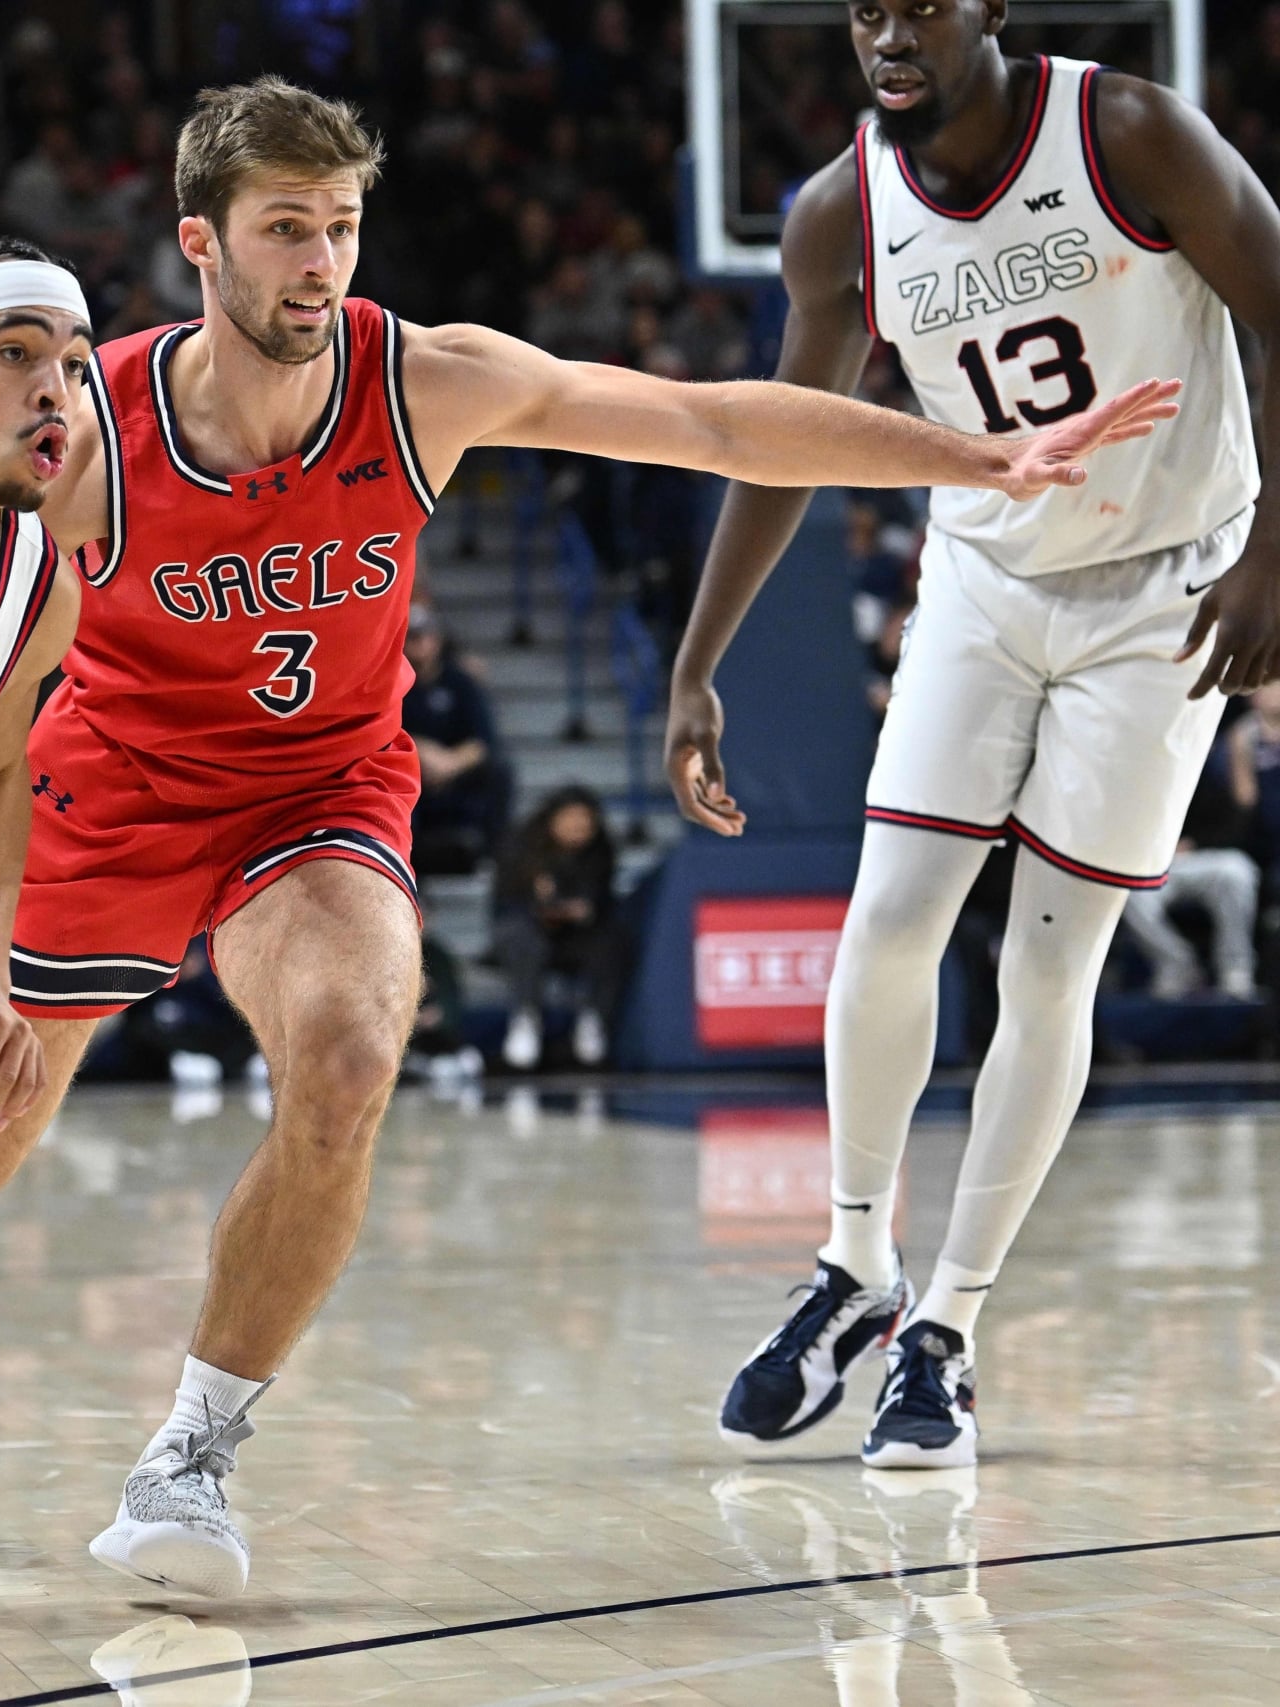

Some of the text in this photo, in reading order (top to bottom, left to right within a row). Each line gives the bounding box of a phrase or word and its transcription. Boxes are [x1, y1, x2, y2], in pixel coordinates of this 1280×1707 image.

[1023, 189, 1066, 215] WCC
[899, 228, 1098, 336] ZAGS
[957, 315, 1098, 434] 13
[336, 457, 390, 488] WCC
[150, 532, 401, 623] GAELS
[248, 630, 319, 719] 3
